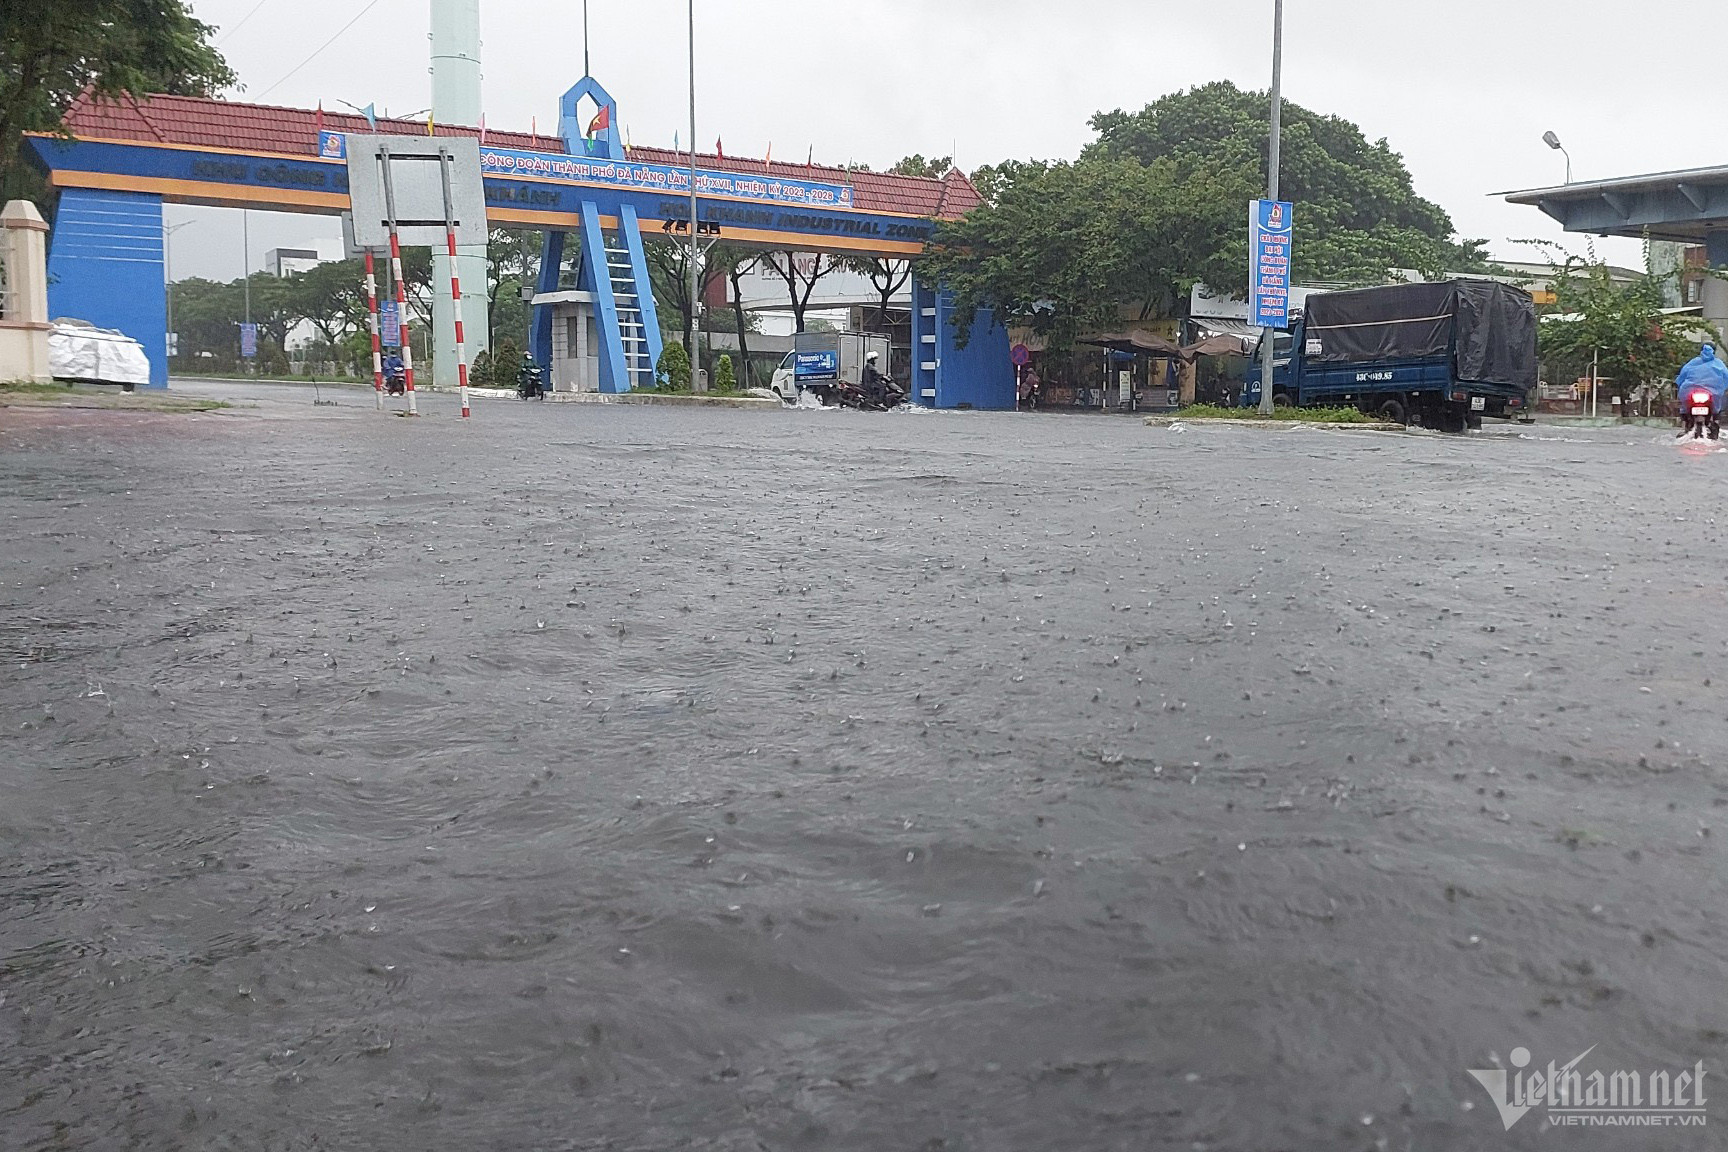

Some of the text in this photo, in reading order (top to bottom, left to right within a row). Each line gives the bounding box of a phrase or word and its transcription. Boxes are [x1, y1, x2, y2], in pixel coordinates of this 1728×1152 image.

[481, 152, 514, 167] CÔNG
[517, 156, 550, 171] ĐOÀN
[553, 160, 589, 175] THÀNH
[592, 163, 614, 177] PHỐ
[617, 168, 632, 179] ĐÀ
[635, 167, 665, 183] NẴNG
[668, 170, 688, 186] LẦN
[689, 174, 708, 187] HỨ
[736, 180, 767, 195] NHIỆM
[783, 186, 804, 198] 2023
[812, 190, 834, 200] 2028
[777, 211, 881, 235] INDUSTRIAL
